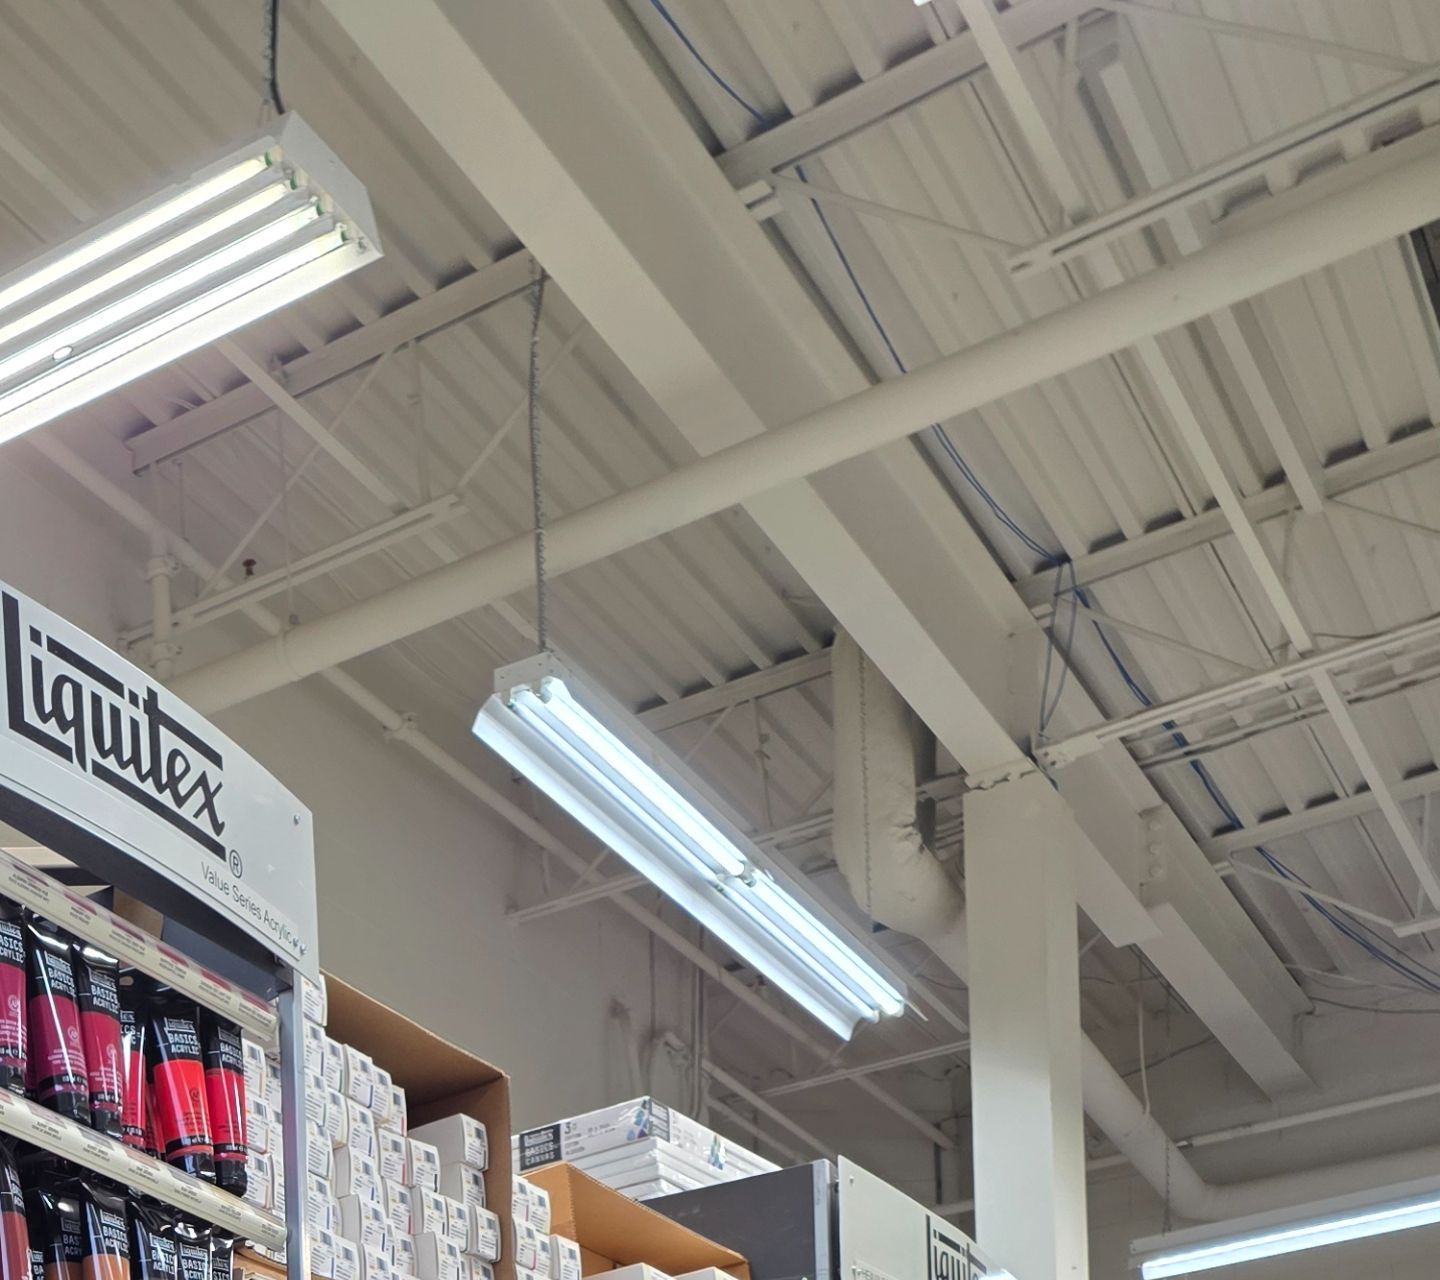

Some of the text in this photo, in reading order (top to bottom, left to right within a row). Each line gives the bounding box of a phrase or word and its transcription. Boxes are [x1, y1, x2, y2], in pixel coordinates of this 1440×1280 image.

[1, 590, 227, 863] Liquitex
[200, 861, 230, 895] Value
[232, 883, 262, 922] Series
